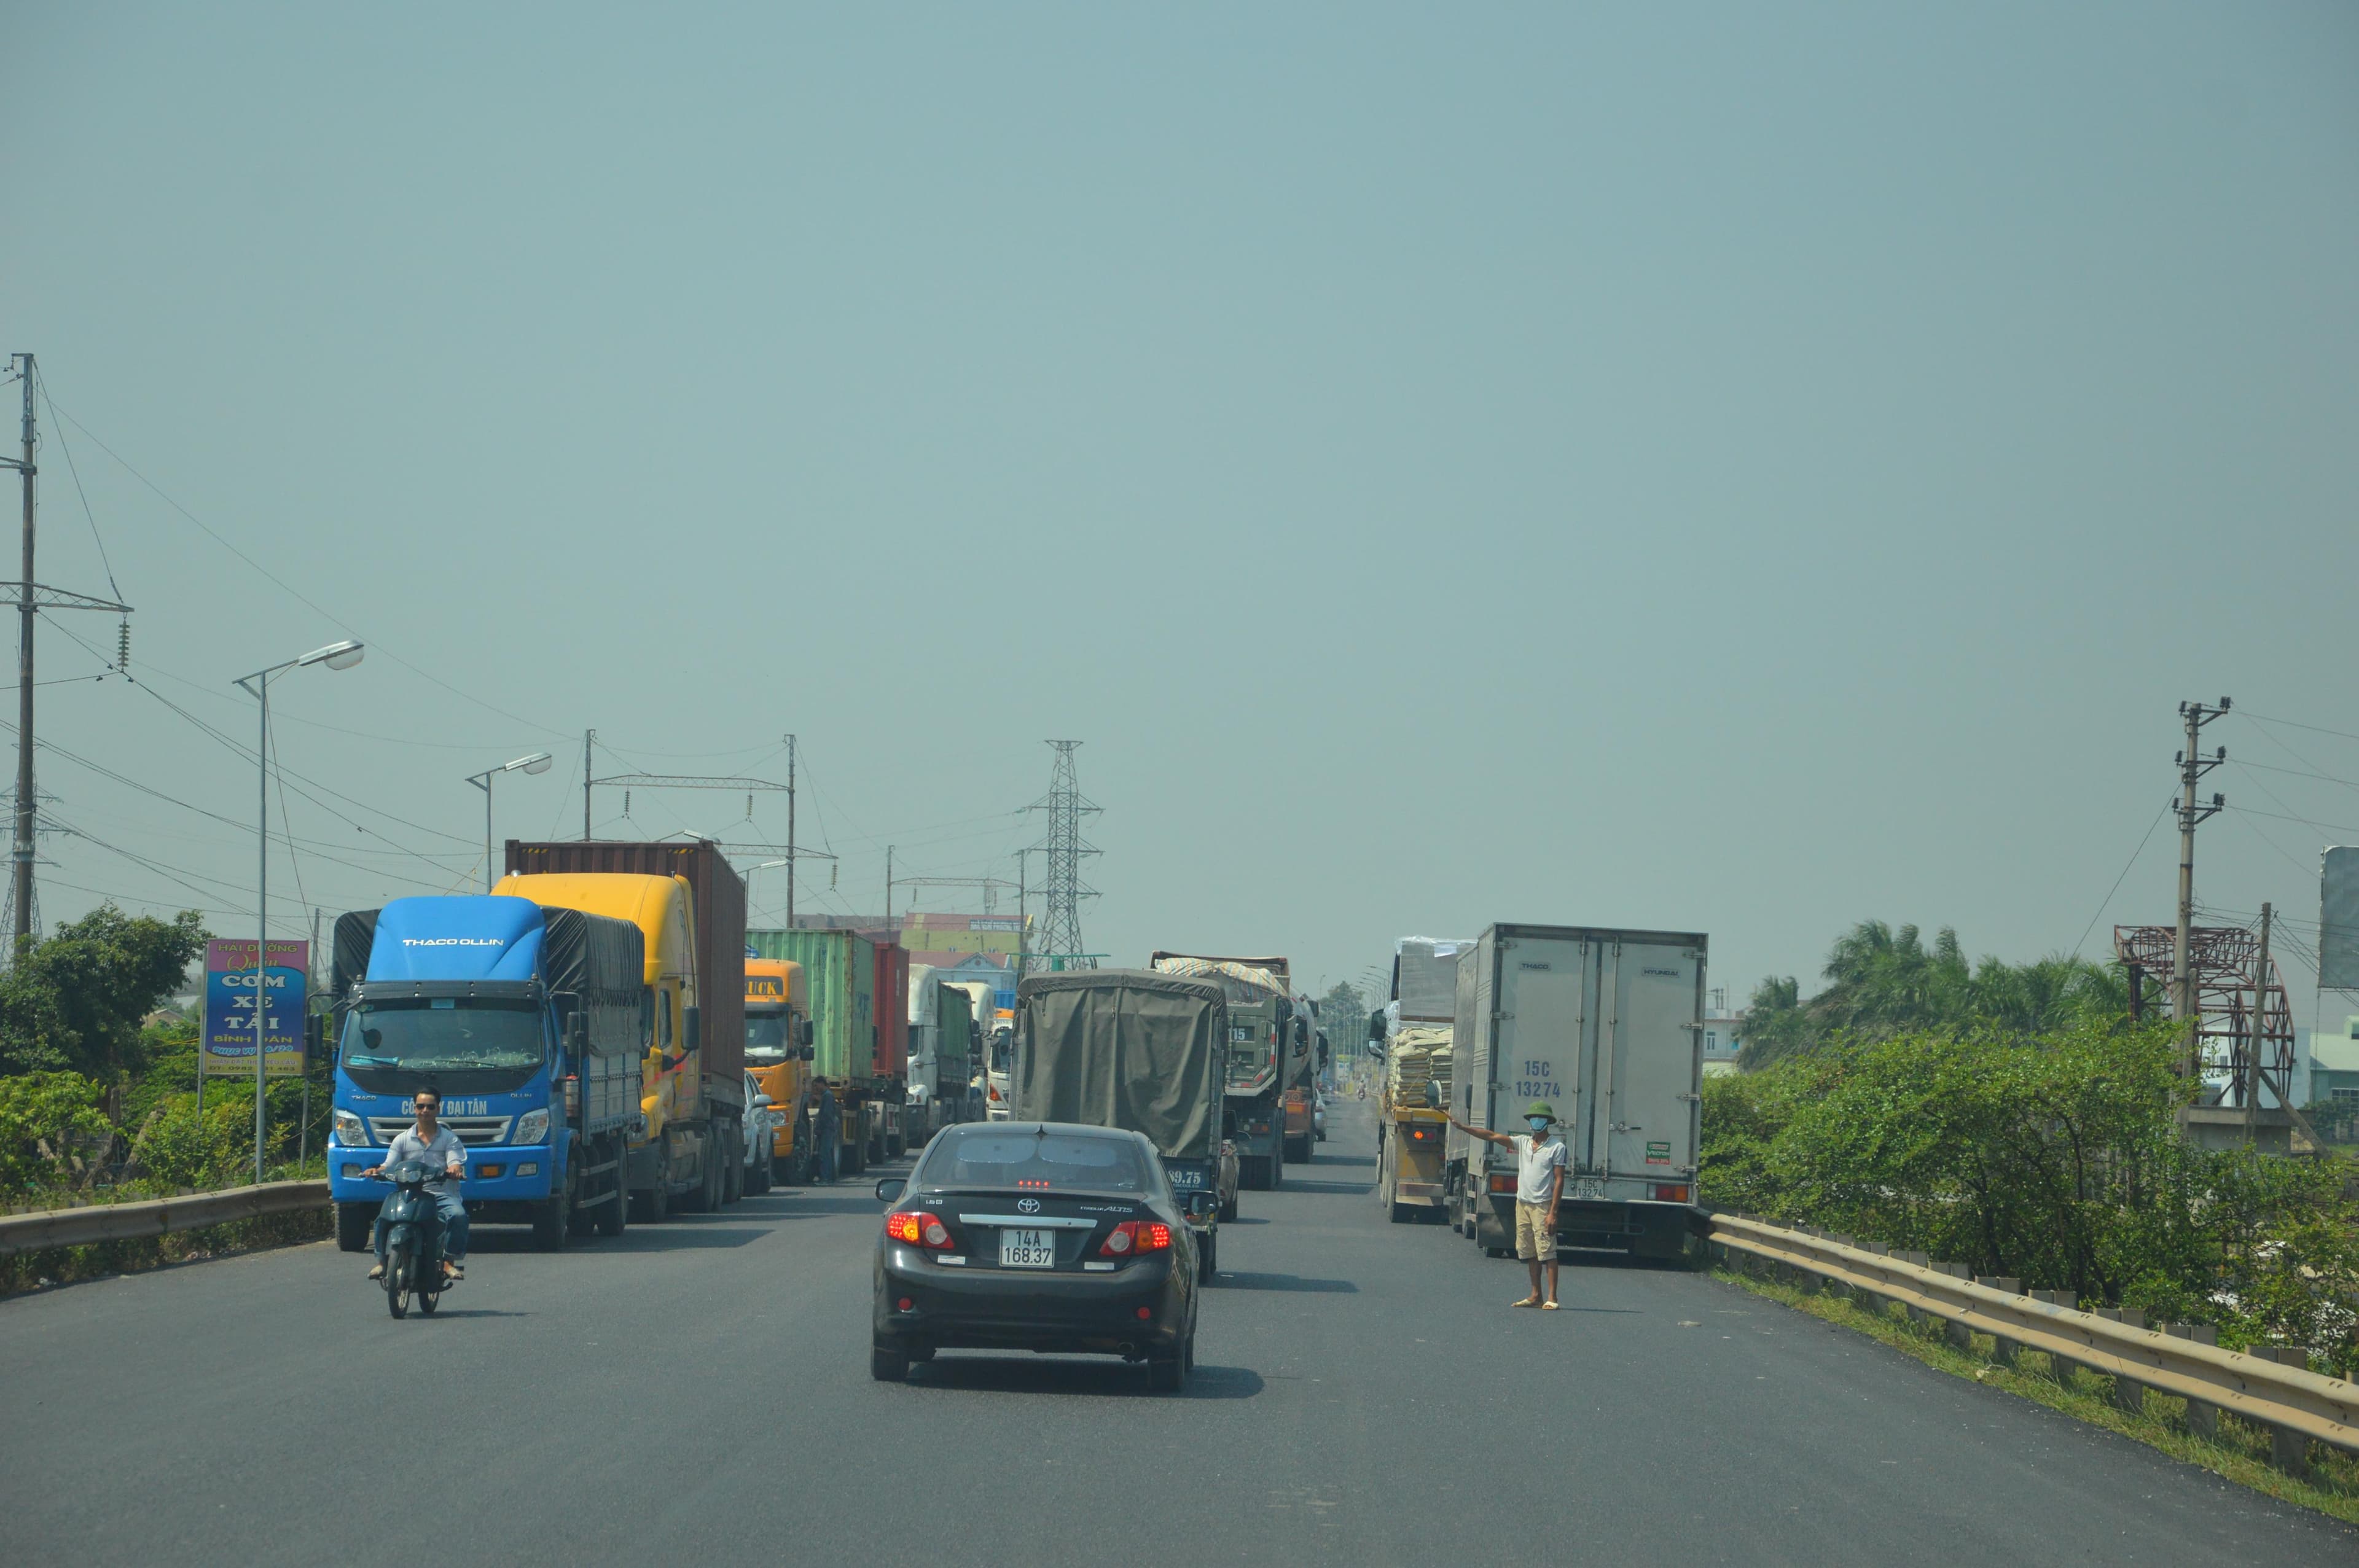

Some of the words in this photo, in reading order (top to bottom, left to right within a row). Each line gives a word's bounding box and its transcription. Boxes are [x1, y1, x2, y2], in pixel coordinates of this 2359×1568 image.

[746, 981, 777, 995] UCK
[1524, 1061, 1550, 1077] 15C
[1516, 1081, 1561, 1098] 13274
[447, 1100, 464, 1117] ĐẠI
[467, 1098, 487, 1115] TÂN
[1584, 1179, 1598, 1188] 15C
[1016, 1230, 1041, 1247] 14A
[1005, 1247, 1052, 1264] 168.37
